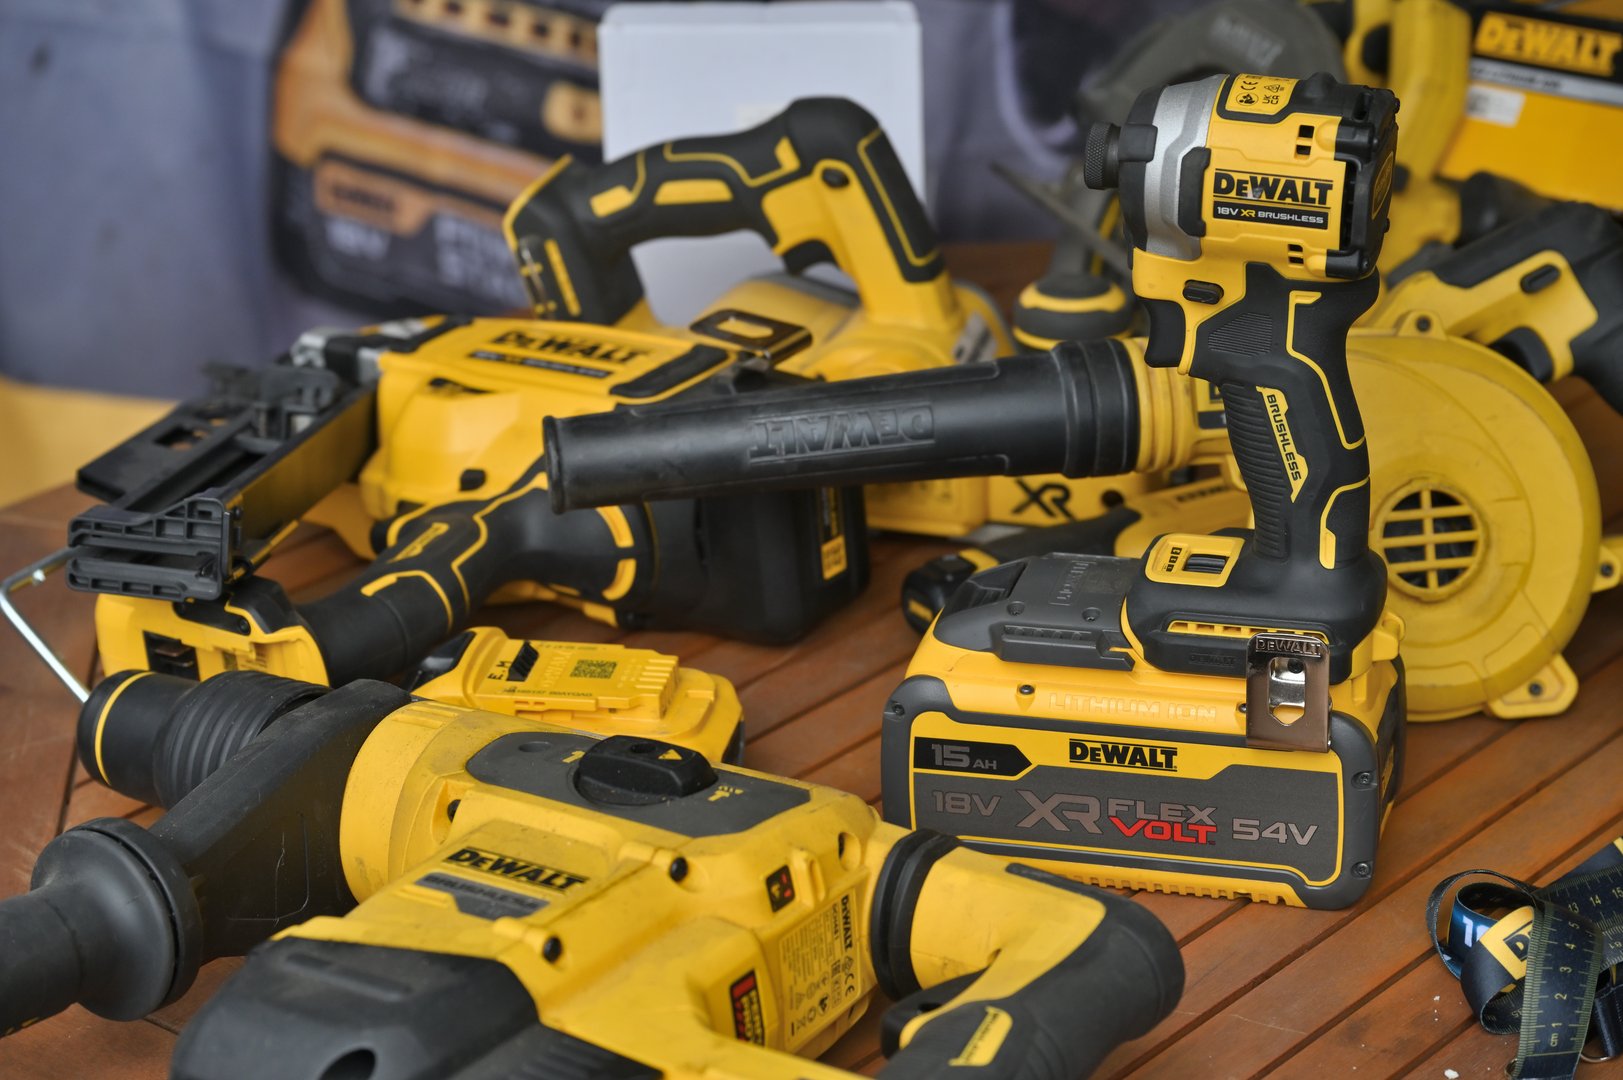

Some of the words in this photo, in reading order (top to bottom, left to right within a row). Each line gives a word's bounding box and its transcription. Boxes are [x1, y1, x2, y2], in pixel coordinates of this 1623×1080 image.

[1475, 12, 1621, 76] DEWALT
[1213, 171, 1333, 206] DEWALT
[1217, 206, 1238, 217] 18V
[1240, 208, 1256, 218] XR
[1258, 210, 1324, 224] BRUSHLESS
[491, 330, 648, 364] DEWALT
[750, 404, 935, 459] DEWALT
[1266, 394, 1302, 482] BRUSHLESS
[1012, 478, 1077, 522] XR
[1256, 637, 1322, 657] DEWALT
[1049, 692, 1161, 720] LITHIUM
[1167, 702, 1217, 722] ION
[931, 743, 971, 767] 15
[972, 758, 998, 771] AH
[1069, 740, 1178, 770] DEWALT
[932, 789, 1002, 817] 18V
[1015, 788, 1103, 835] XR
[1107, 797, 1218, 826] FLEX
[1108, 815, 1218, 845] VOLT
[1231, 817, 1319, 847] 54V
[446, 847, 588, 890] DEWALT
[1568, 902, 1580, 914] 13
[1590, 894, 1602, 907] 14
[841, 894, 854, 949] DEWALT
[1568, 920, 1580, 930] 5
[1564, 942, 1577, 951] 4
[1559, 965, 1573, 975] 3
[1554, 992, 1568, 1000] 2
[1550, 1032, 1559, 1047] cm
